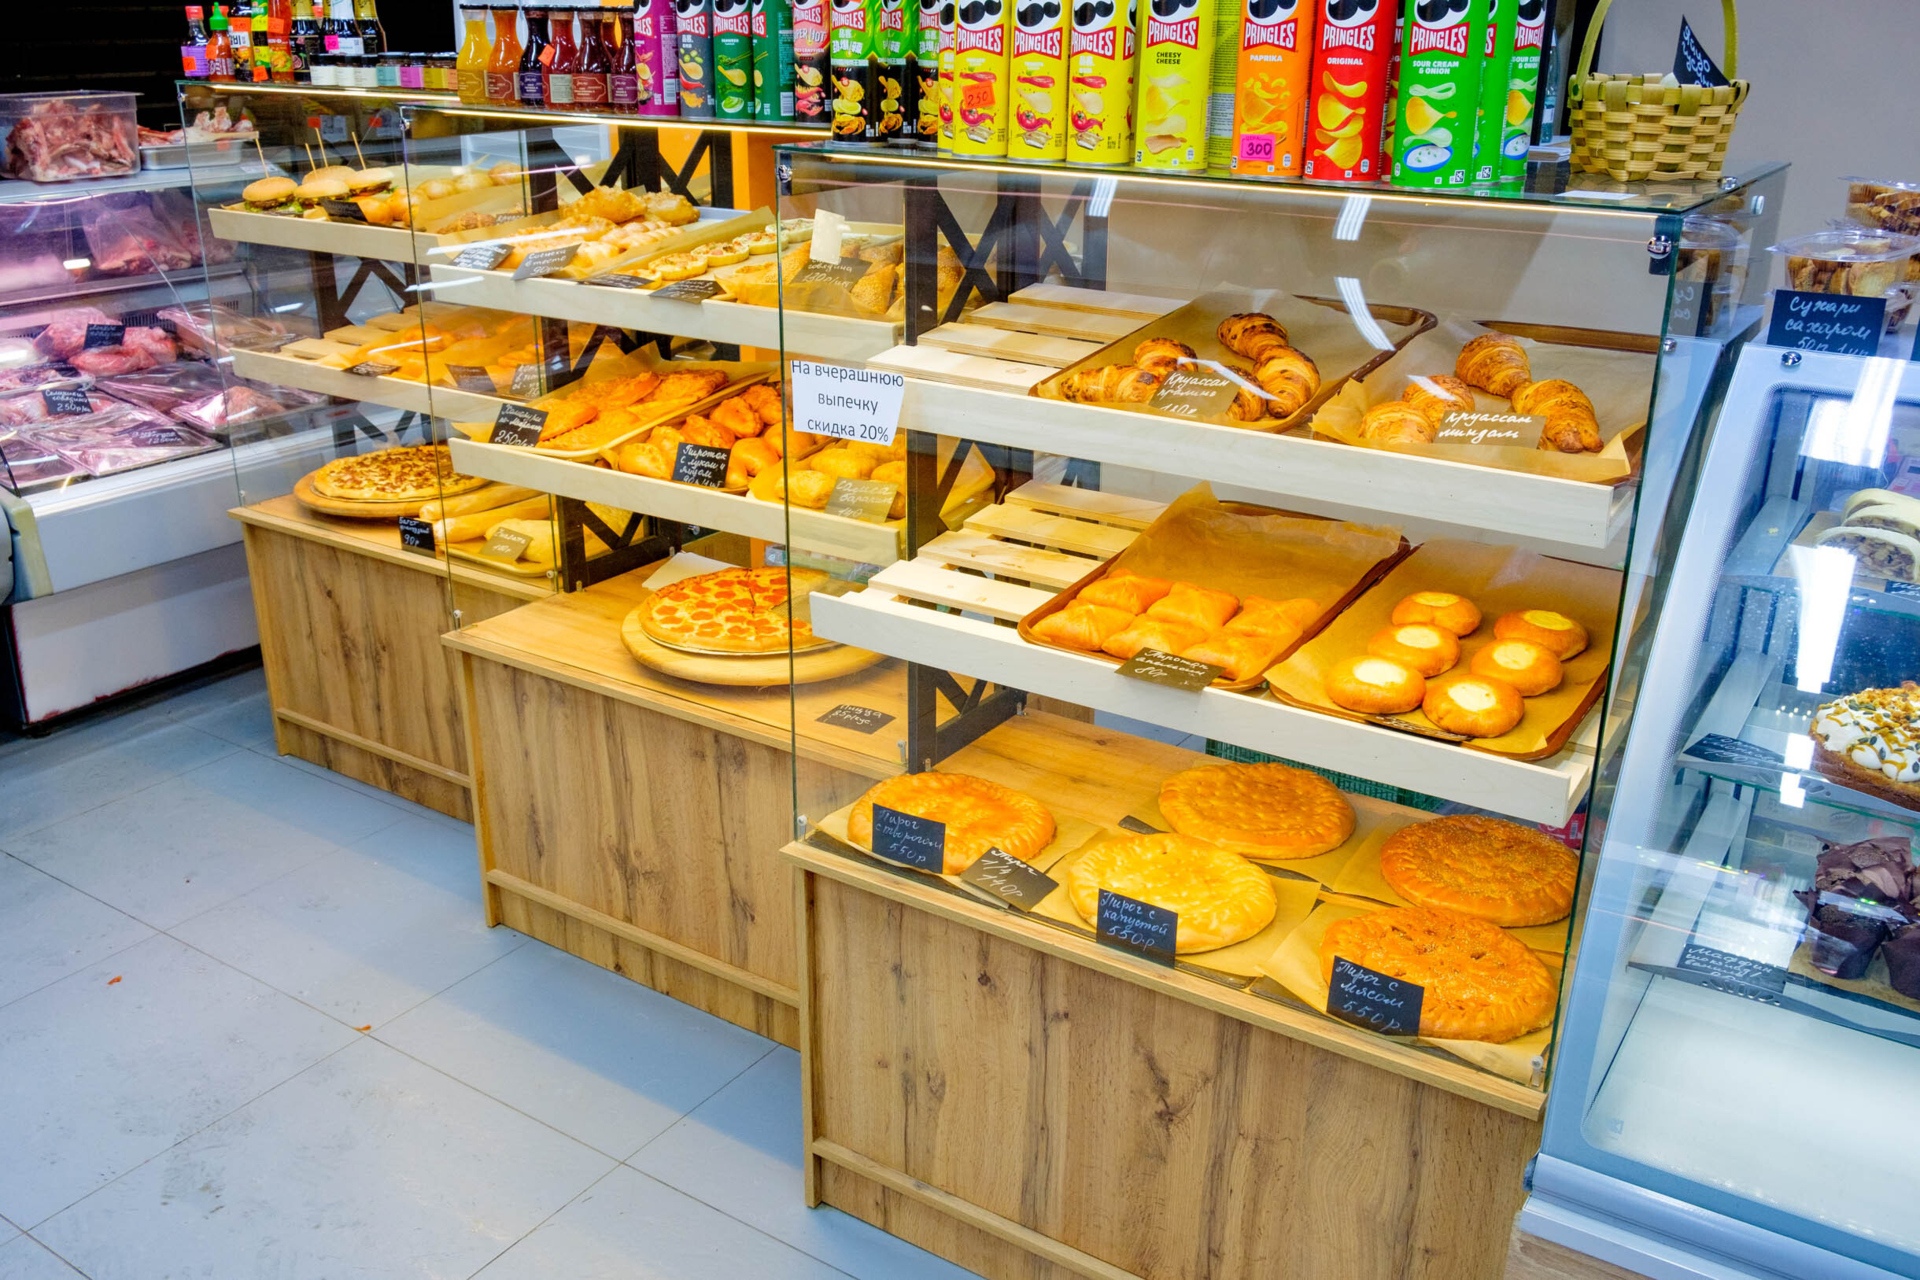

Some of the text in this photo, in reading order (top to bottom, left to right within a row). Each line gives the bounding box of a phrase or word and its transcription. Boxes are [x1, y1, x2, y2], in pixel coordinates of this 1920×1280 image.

[713, 15, 749, 34] PRINGLES
[1148, 20, 1196, 46] PRINGLES
[1244, 21, 1295, 48] PRINGLES
[1323, 23, 1375, 51] PRINGLES
[957, 27, 1002, 52] PRINGLES
[1015, 30, 1061, 56] PRINGLES
[1072, 30, 1114, 56] PRINGLES
[1411, 24, 1468, 54] PRINGLES
[1156, 51, 1182, 59] CHEESY
[1250, 54, 1283, 62] PAPRIKA
[1246, 142, 1272, 156] 300
[1789, 296, 1861, 318] Сухари
[1785, 318, 1872, 340] сахаром
[791, 360, 904, 387] На вчерашнюю
[818, 393, 878, 415] выпечку
[807, 419, 889, 442] скидка 20%
[1101, 892, 1143, 914] Пирог
[1103, 909, 1169, 935] капустой
[1335, 961, 1382, 987] Пирог
